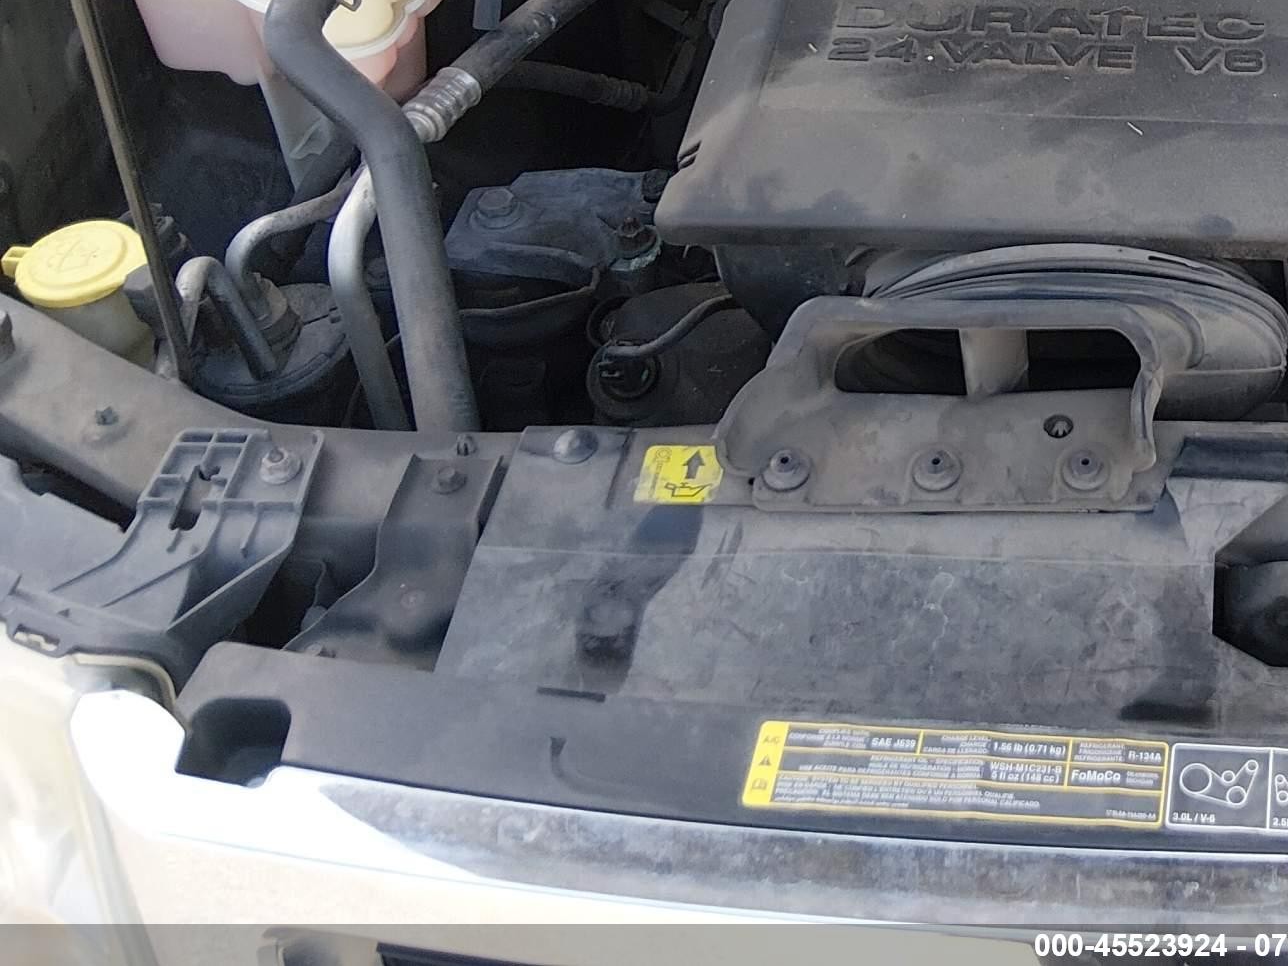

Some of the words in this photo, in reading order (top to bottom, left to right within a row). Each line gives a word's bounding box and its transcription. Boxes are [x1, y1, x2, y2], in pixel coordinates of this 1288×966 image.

[835, 5, 1265, 40] DURATEC
[827, 36, 917, 62] 24
[939, 39, 1135, 69] VALVE
[1175, 45, 1264, 74] V6
[871, 737, 892, 746] SAE
[894, 738, 917, 748] J639
[993, 741, 1012, 751] 1.56
[1014, 743, 1023, 752] lb
[1025, 743, 1048, 753] (0.71
[1050, 745, 1066, 755] kg)
[1128, 750, 1161, 762] R-134A
[1043, 774, 1060, 784] cc)
[1071, 769, 1121, 781] FoMoCo
[1173, 812, 1192, 822] 3.0L
[1200, 814, 1216, 823] V-6
